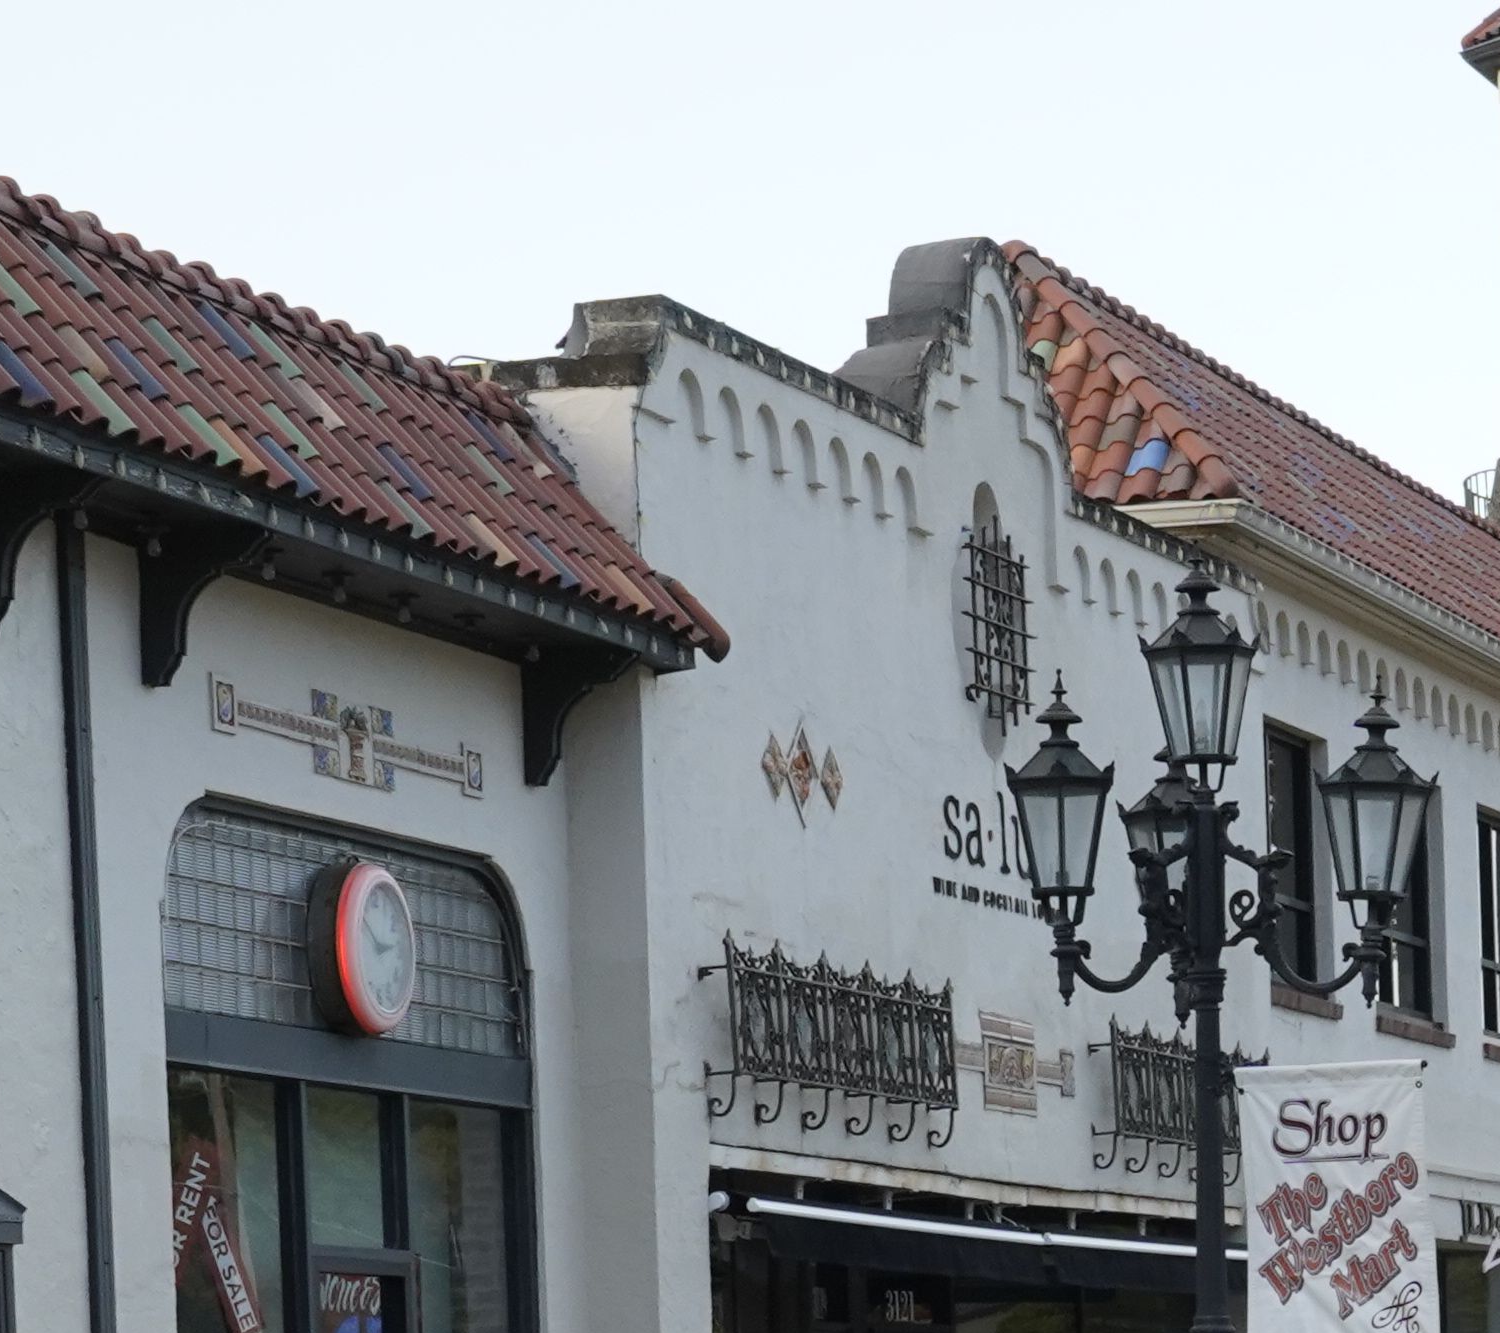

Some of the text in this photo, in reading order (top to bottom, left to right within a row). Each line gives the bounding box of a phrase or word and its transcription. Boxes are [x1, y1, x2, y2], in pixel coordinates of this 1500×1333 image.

[932, 876, 958, 899] WINE
[961, 883, 980, 904] AND
[983, 889, 1029, 917] COCKTAIL
[1272, 1098, 1388, 1164] Shop
[175, 1151, 211, 1226] RENT
[1256, 1172, 1328, 1247] The
[1258, 1151, 1419, 1306] Westboro
[222, 1264, 256, 1331] SALE
[1329, 1218, 1419, 1321] Mart
[884, 1289, 915, 1323] 3121
